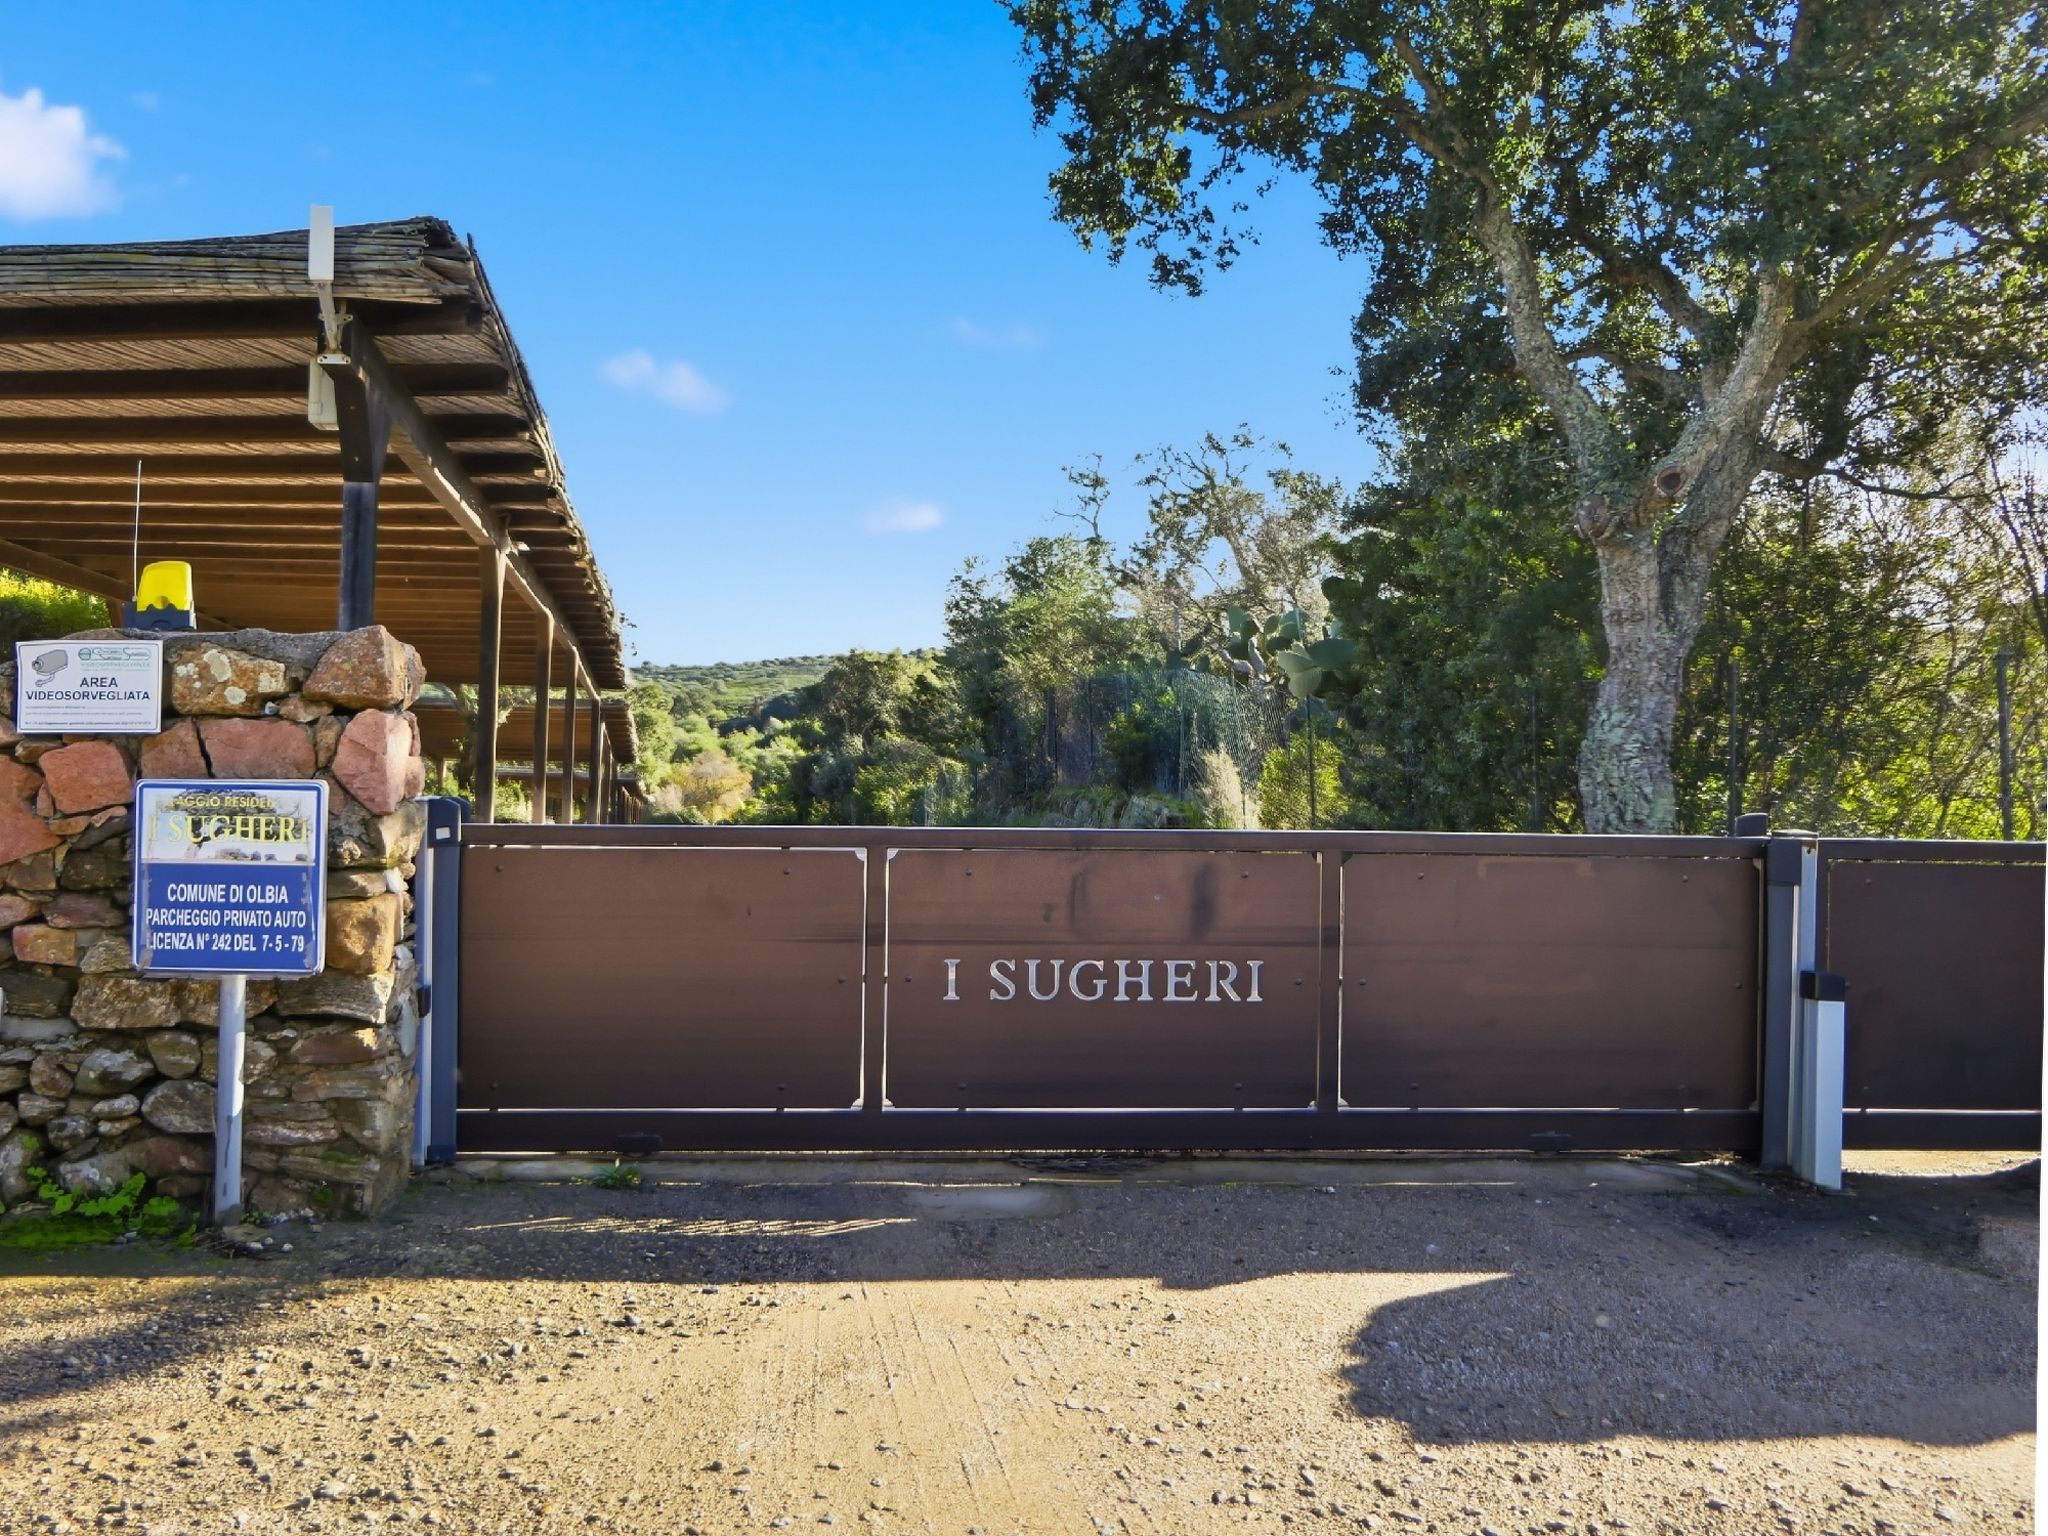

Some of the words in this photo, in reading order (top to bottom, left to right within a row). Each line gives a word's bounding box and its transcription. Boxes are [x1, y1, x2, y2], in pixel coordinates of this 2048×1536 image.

[80, 677, 118, 687] AREA
[26, 690, 150, 701] VIDEOSORVEGLIATA
[168, 814, 307, 843] SUGHERI
[168, 884, 225, 902] COMUNE
[230, 885, 243, 902] DI
[247, 885, 288, 904] OLBIA
[146, 908, 221, 926] PARCHEGGIO
[224, 910, 272, 927] PRIVATO
[274, 911, 306, 928] AUTO
[212, 933, 232, 951] 242
[234, 933, 257, 951] DEL
[943, 958, 961, 1000] I
[989, 958, 1264, 1002] SUGHERI
